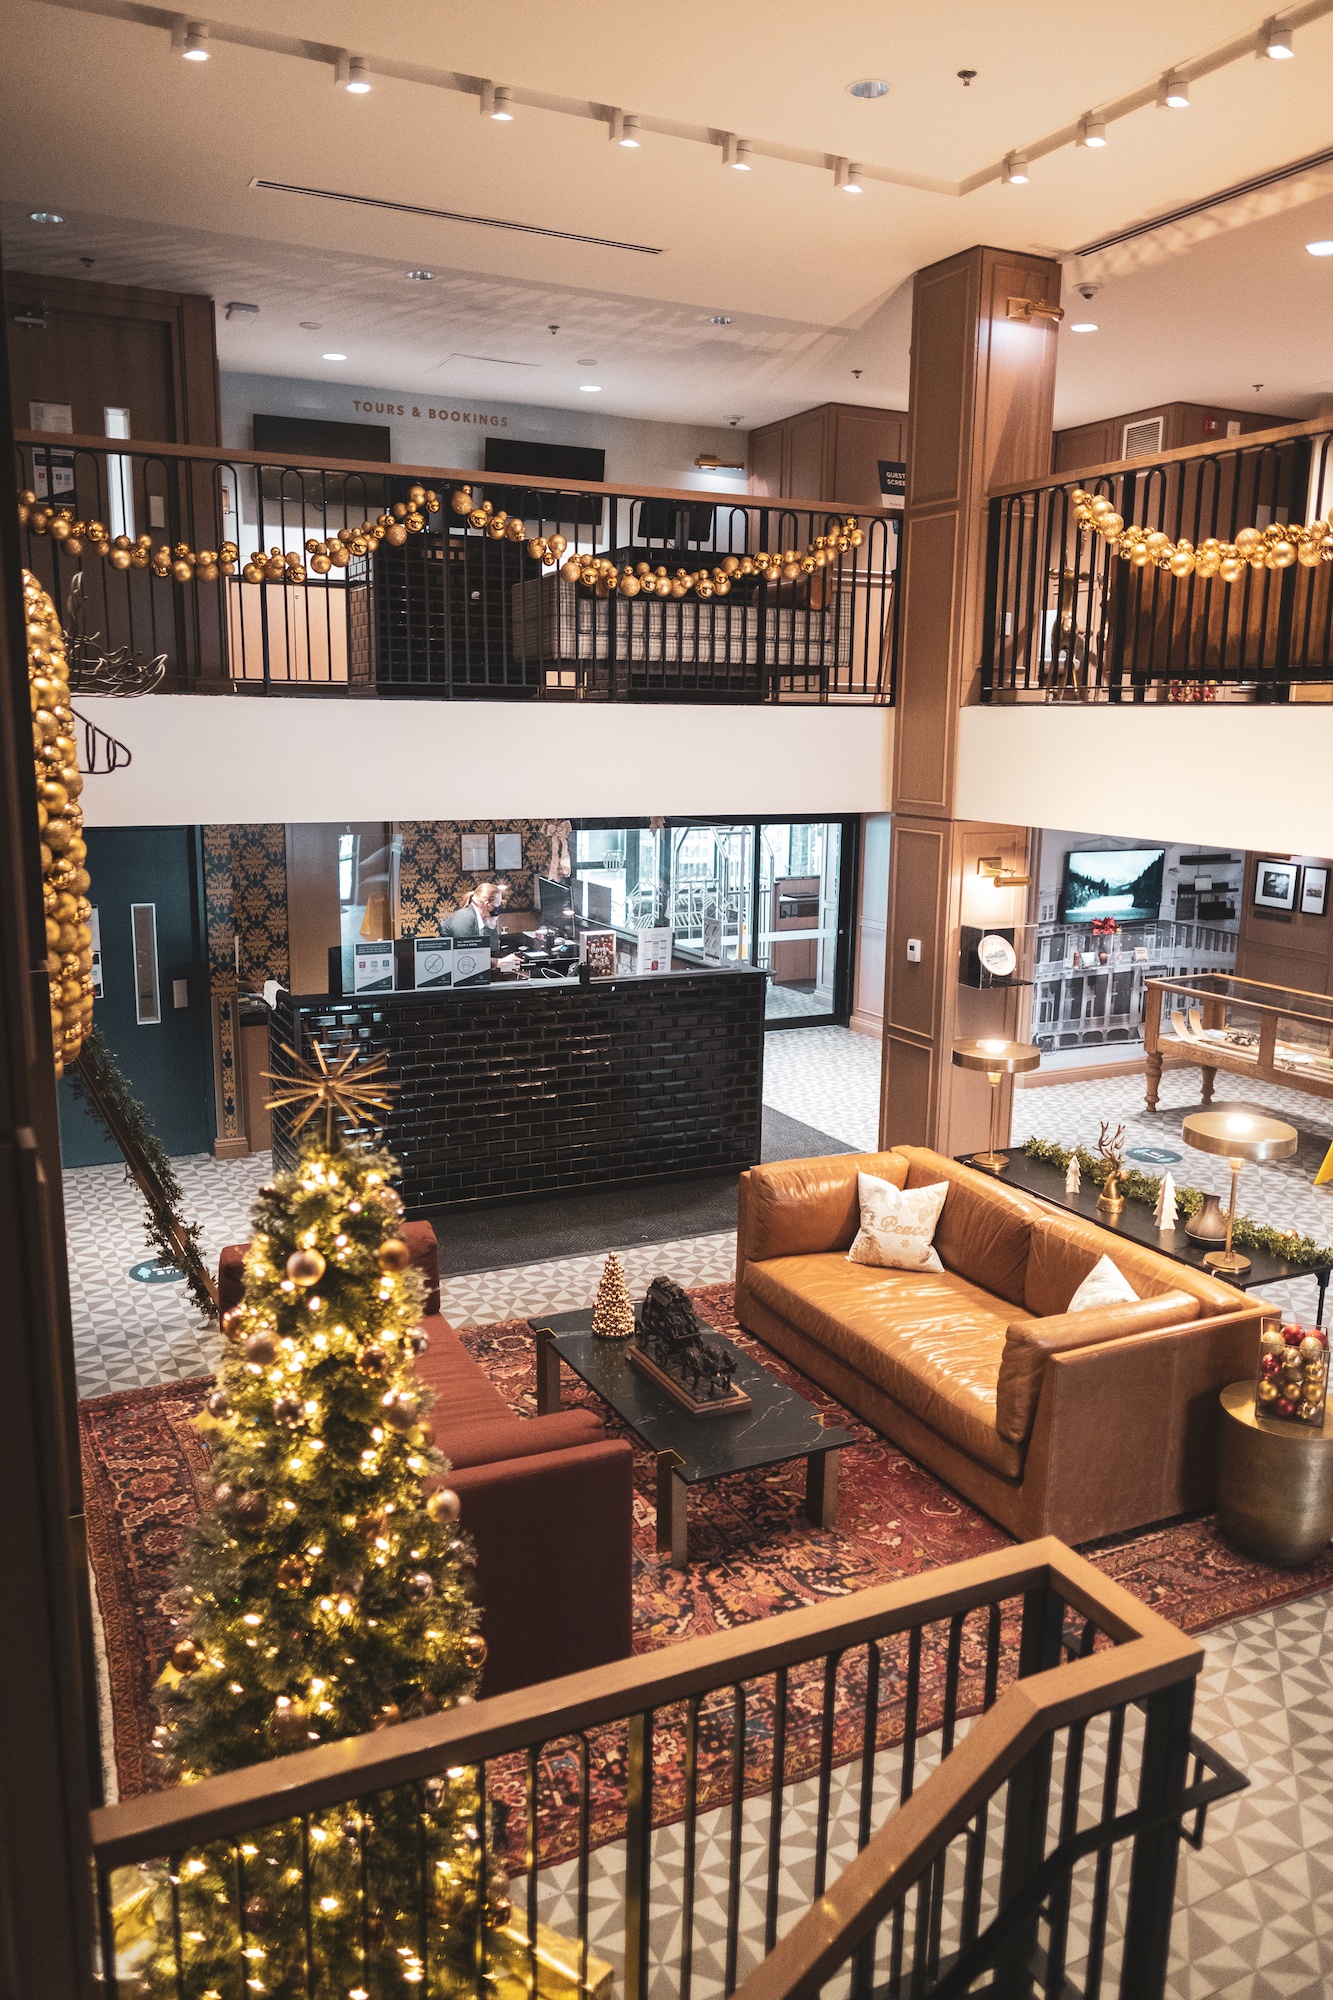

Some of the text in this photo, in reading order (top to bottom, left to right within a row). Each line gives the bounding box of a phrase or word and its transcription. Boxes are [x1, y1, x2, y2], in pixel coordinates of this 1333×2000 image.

[353, 400, 508, 427] TOURS & BOOKINGS
[877, 1215, 931, 1237] Peace
